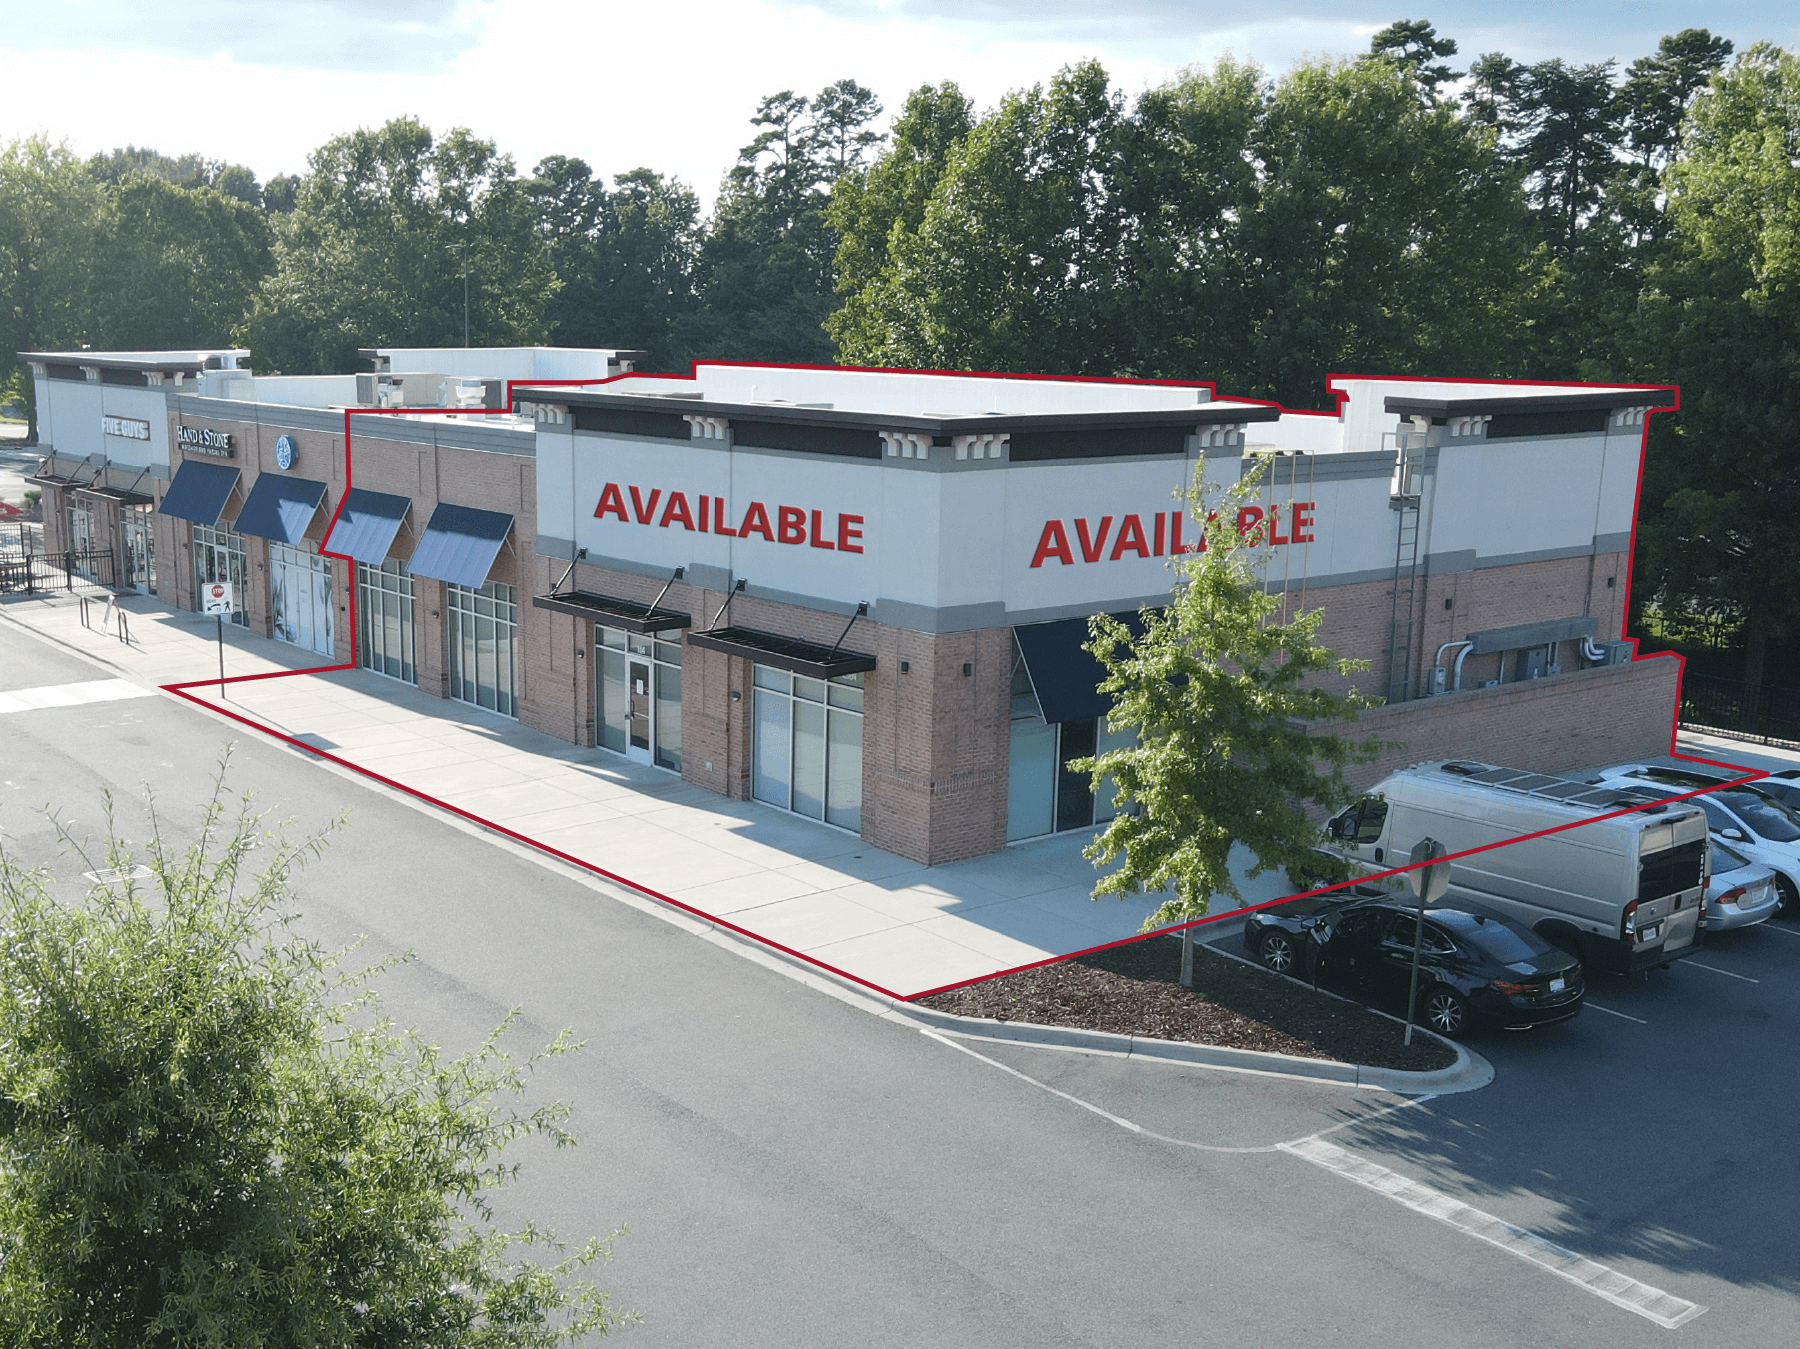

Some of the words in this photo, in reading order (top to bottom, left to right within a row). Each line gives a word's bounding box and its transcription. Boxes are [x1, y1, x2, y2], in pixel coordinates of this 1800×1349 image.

[101, 417, 121, 436] FIVE
[121, 420, 146, 440] GUYS
[176, 425, 198, 443] HAND
[198, 431, 204, 445] &
[203, 429, 229, 448] STONE
